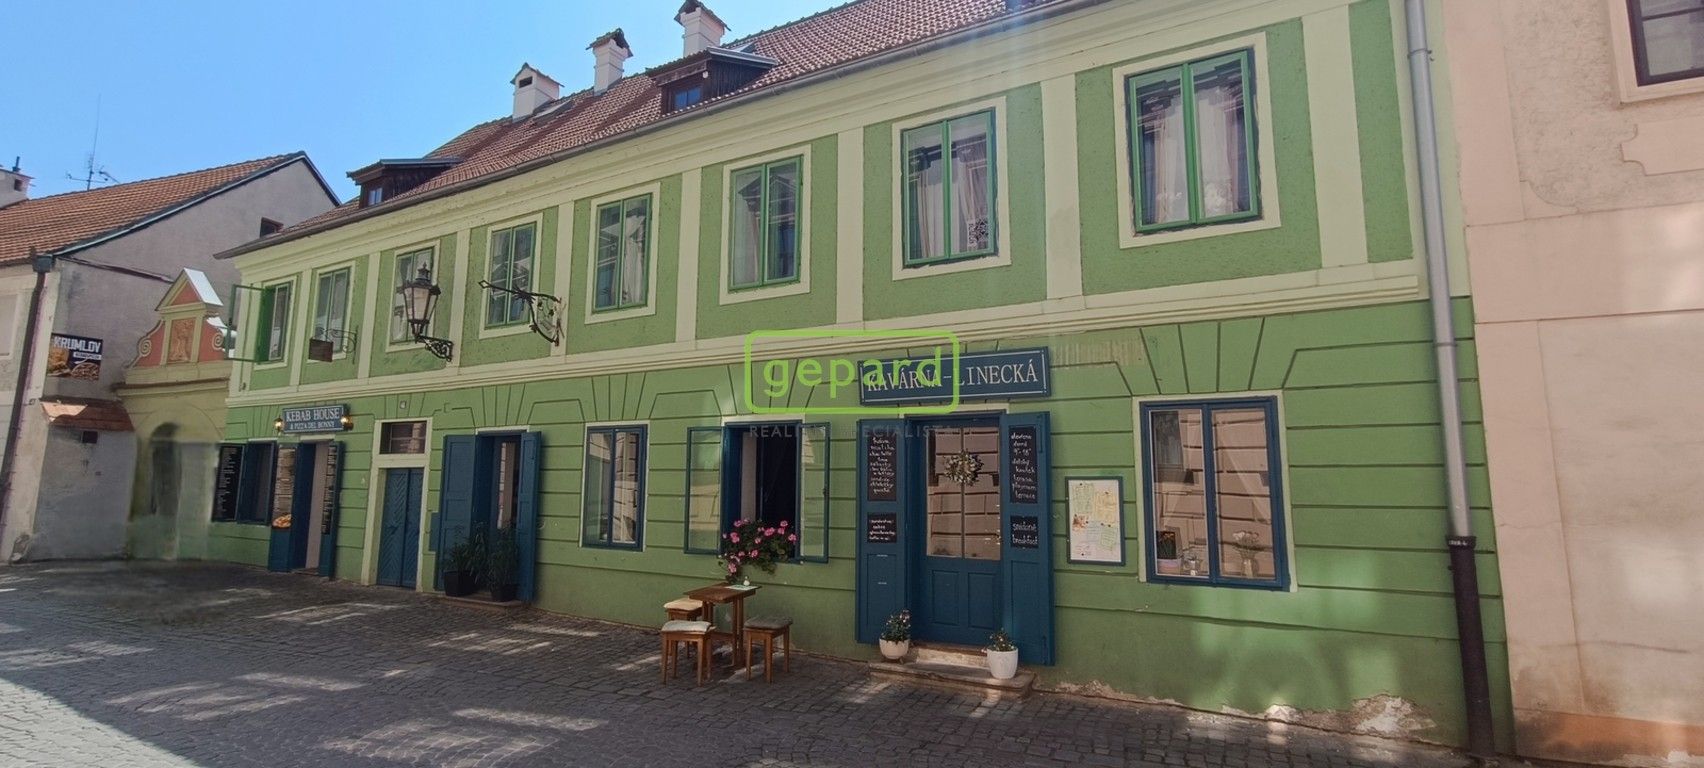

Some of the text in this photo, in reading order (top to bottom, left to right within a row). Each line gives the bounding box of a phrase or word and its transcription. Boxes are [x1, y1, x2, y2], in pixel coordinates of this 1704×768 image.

[53, 336, 101, 353] KRUMLOV
[867, 359, 1039, 392] KAVÁRNA-INECKÁ
[286, 407, 340, 422] KEBAB HOUSE
